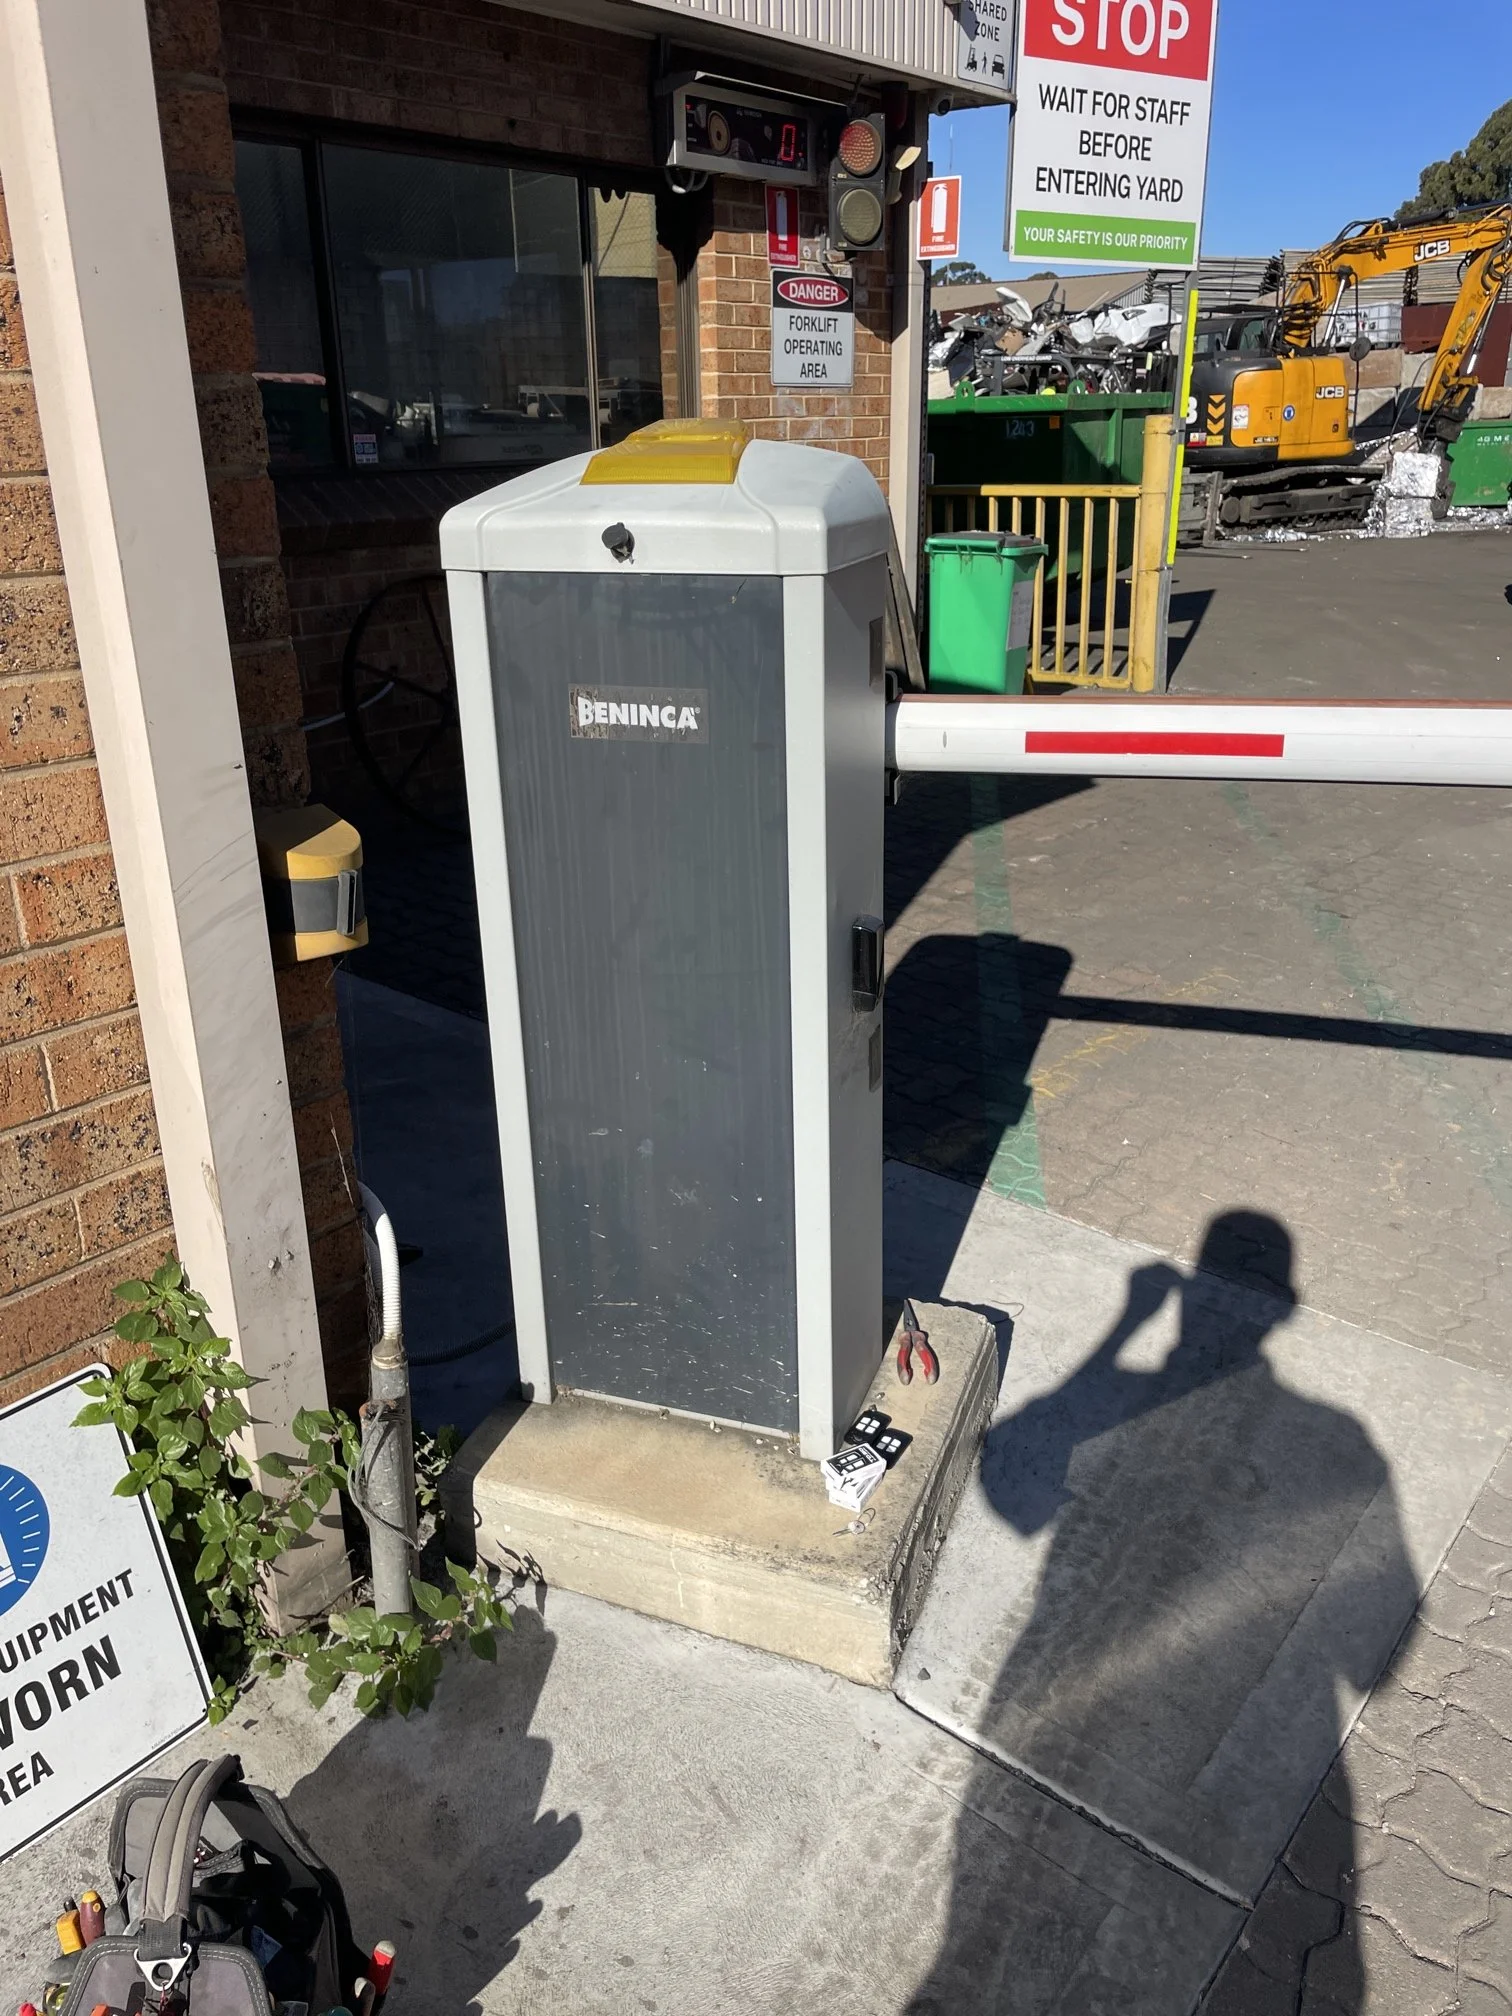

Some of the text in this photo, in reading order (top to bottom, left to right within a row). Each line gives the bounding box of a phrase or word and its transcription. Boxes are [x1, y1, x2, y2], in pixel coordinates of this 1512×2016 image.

[968, 0, 1007, 21] SHARED
[974, 20, 1000, 42] ZONE
[1052, 0, 1189, 60] STOP
[1039, 83, 1191, 126] WAIT FOR STAFF
[1079, 130, 1152, 161] BEFORE
[1036, 166, 1183, 203] ENTERING YARD
[1024, 226, 1188, 250] YOUR SAFETY IS OUR PRIORITY
[1414, 240, 1450, 262] JCB
[789, 282, 839, 301] DANGER
[789, 315, 838, 333] FORKLIFT
[784, 338, 843, 356] OPERATING
[800, 363, 828, 378] AREA
[1316, 386, 1345, 399] JCB
